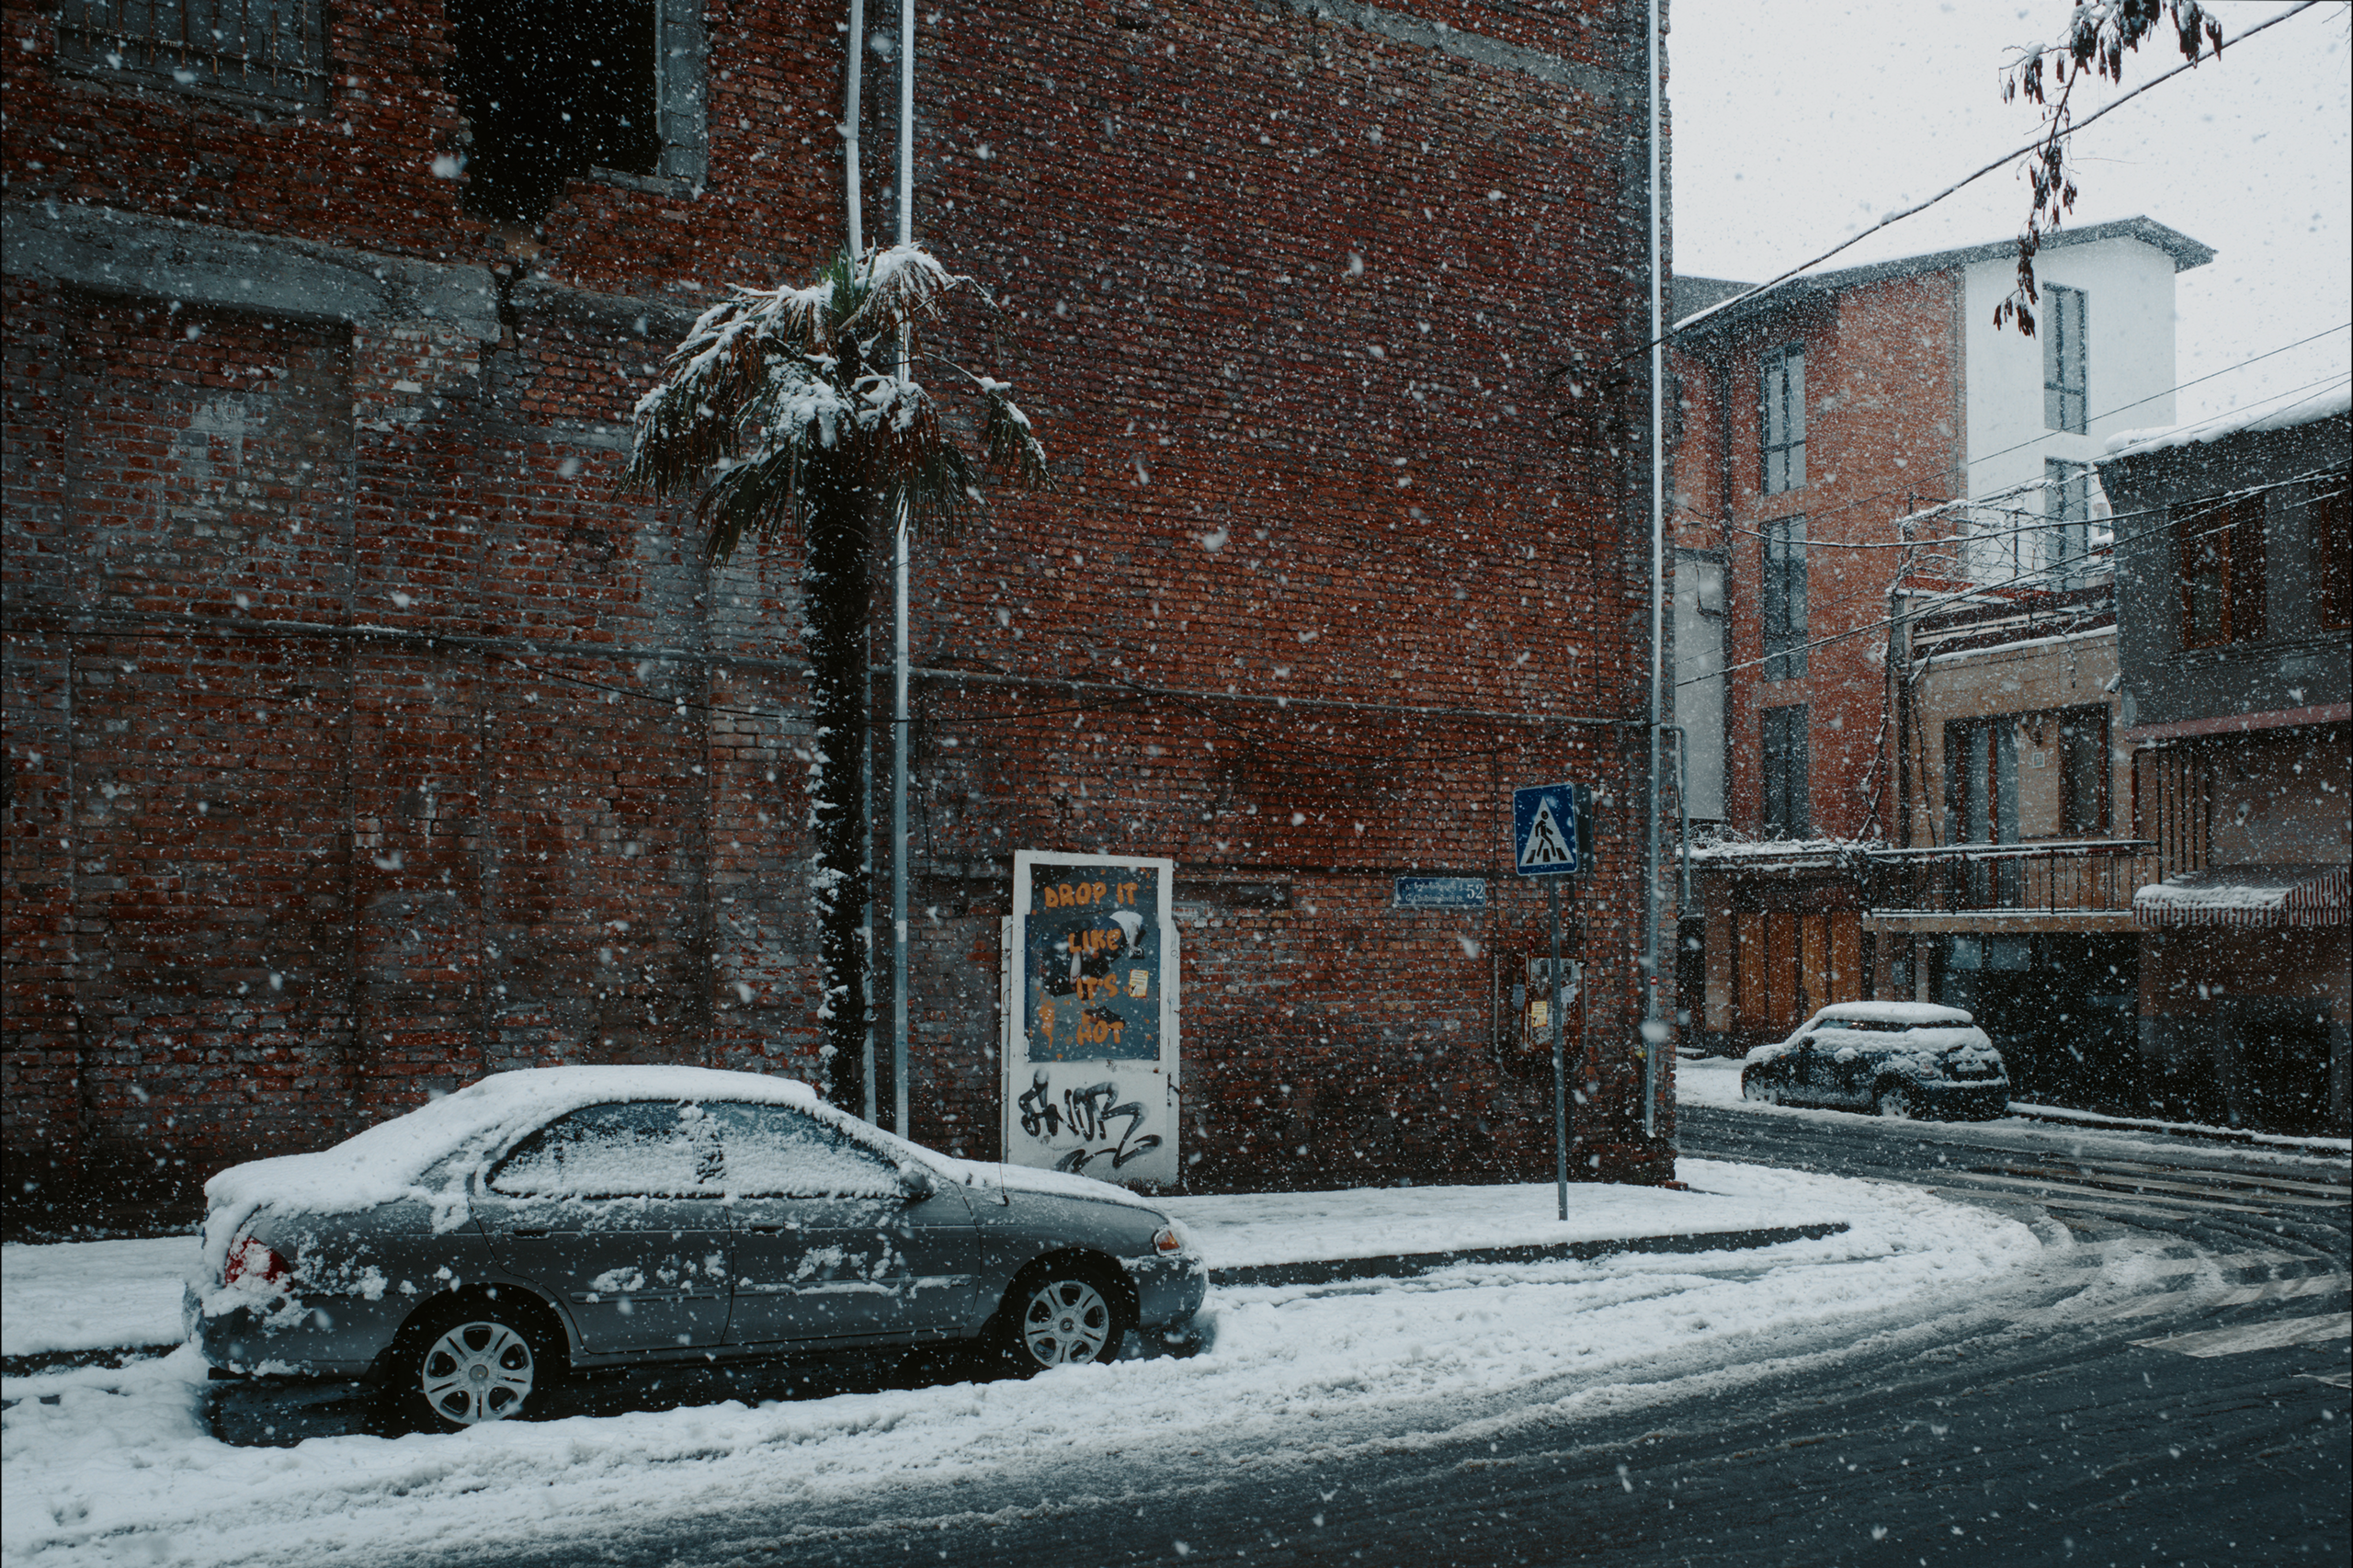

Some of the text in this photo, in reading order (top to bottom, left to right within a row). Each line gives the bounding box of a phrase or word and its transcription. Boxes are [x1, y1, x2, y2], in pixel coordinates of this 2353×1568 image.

[1044, 881, 1138, 908] DROP IT
[1467, 884, 1483, 899] 52
[1068, 928, 1121, 953] LIKE
[1076, 973, 1119, 1000] IT'S
[1076, 1019, 1125, 1046] HOT
